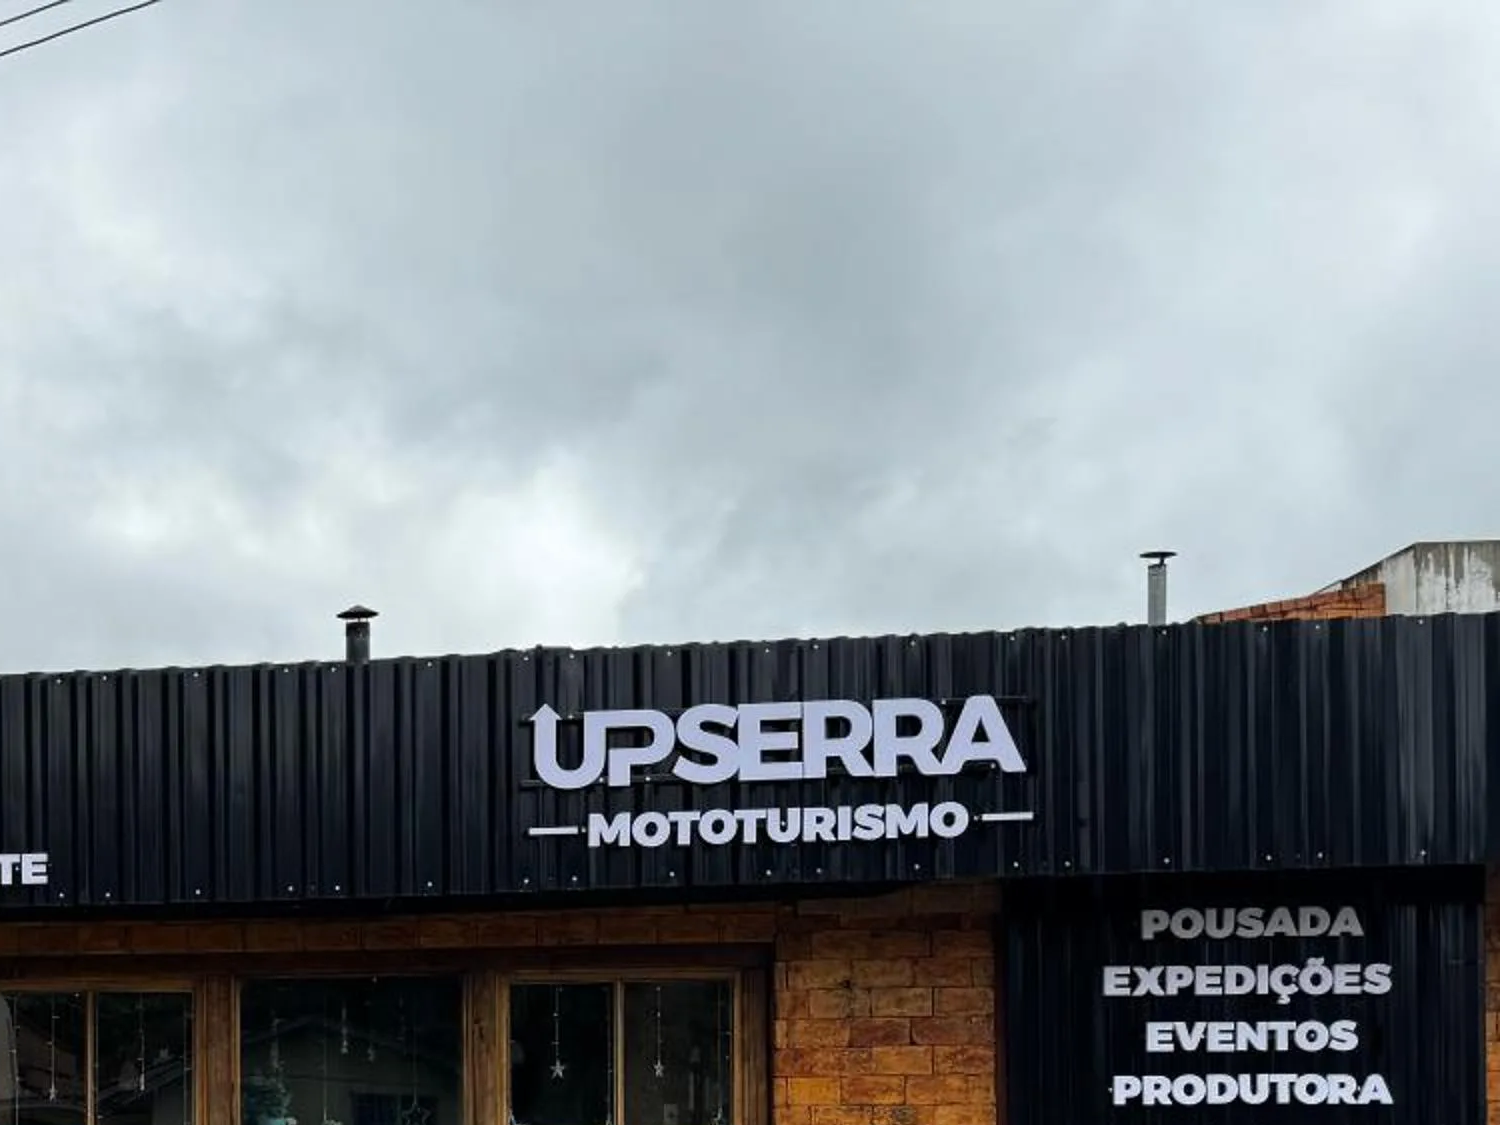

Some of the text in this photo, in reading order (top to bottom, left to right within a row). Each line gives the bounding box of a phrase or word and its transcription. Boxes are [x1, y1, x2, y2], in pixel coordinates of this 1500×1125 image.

[530, 695, 1027, 790] UPSERRA
[588, 801, 969, 848] MOTOTURISMO
[1141, 906, 1365, 940] POUSADA
[1102, 958, 1393, 1005] EXPEDIÇÕES
[1146, 1020, 1359, 1053] EVENTOS
[1113, 1074, 1394, 1106] PRODUTORA
